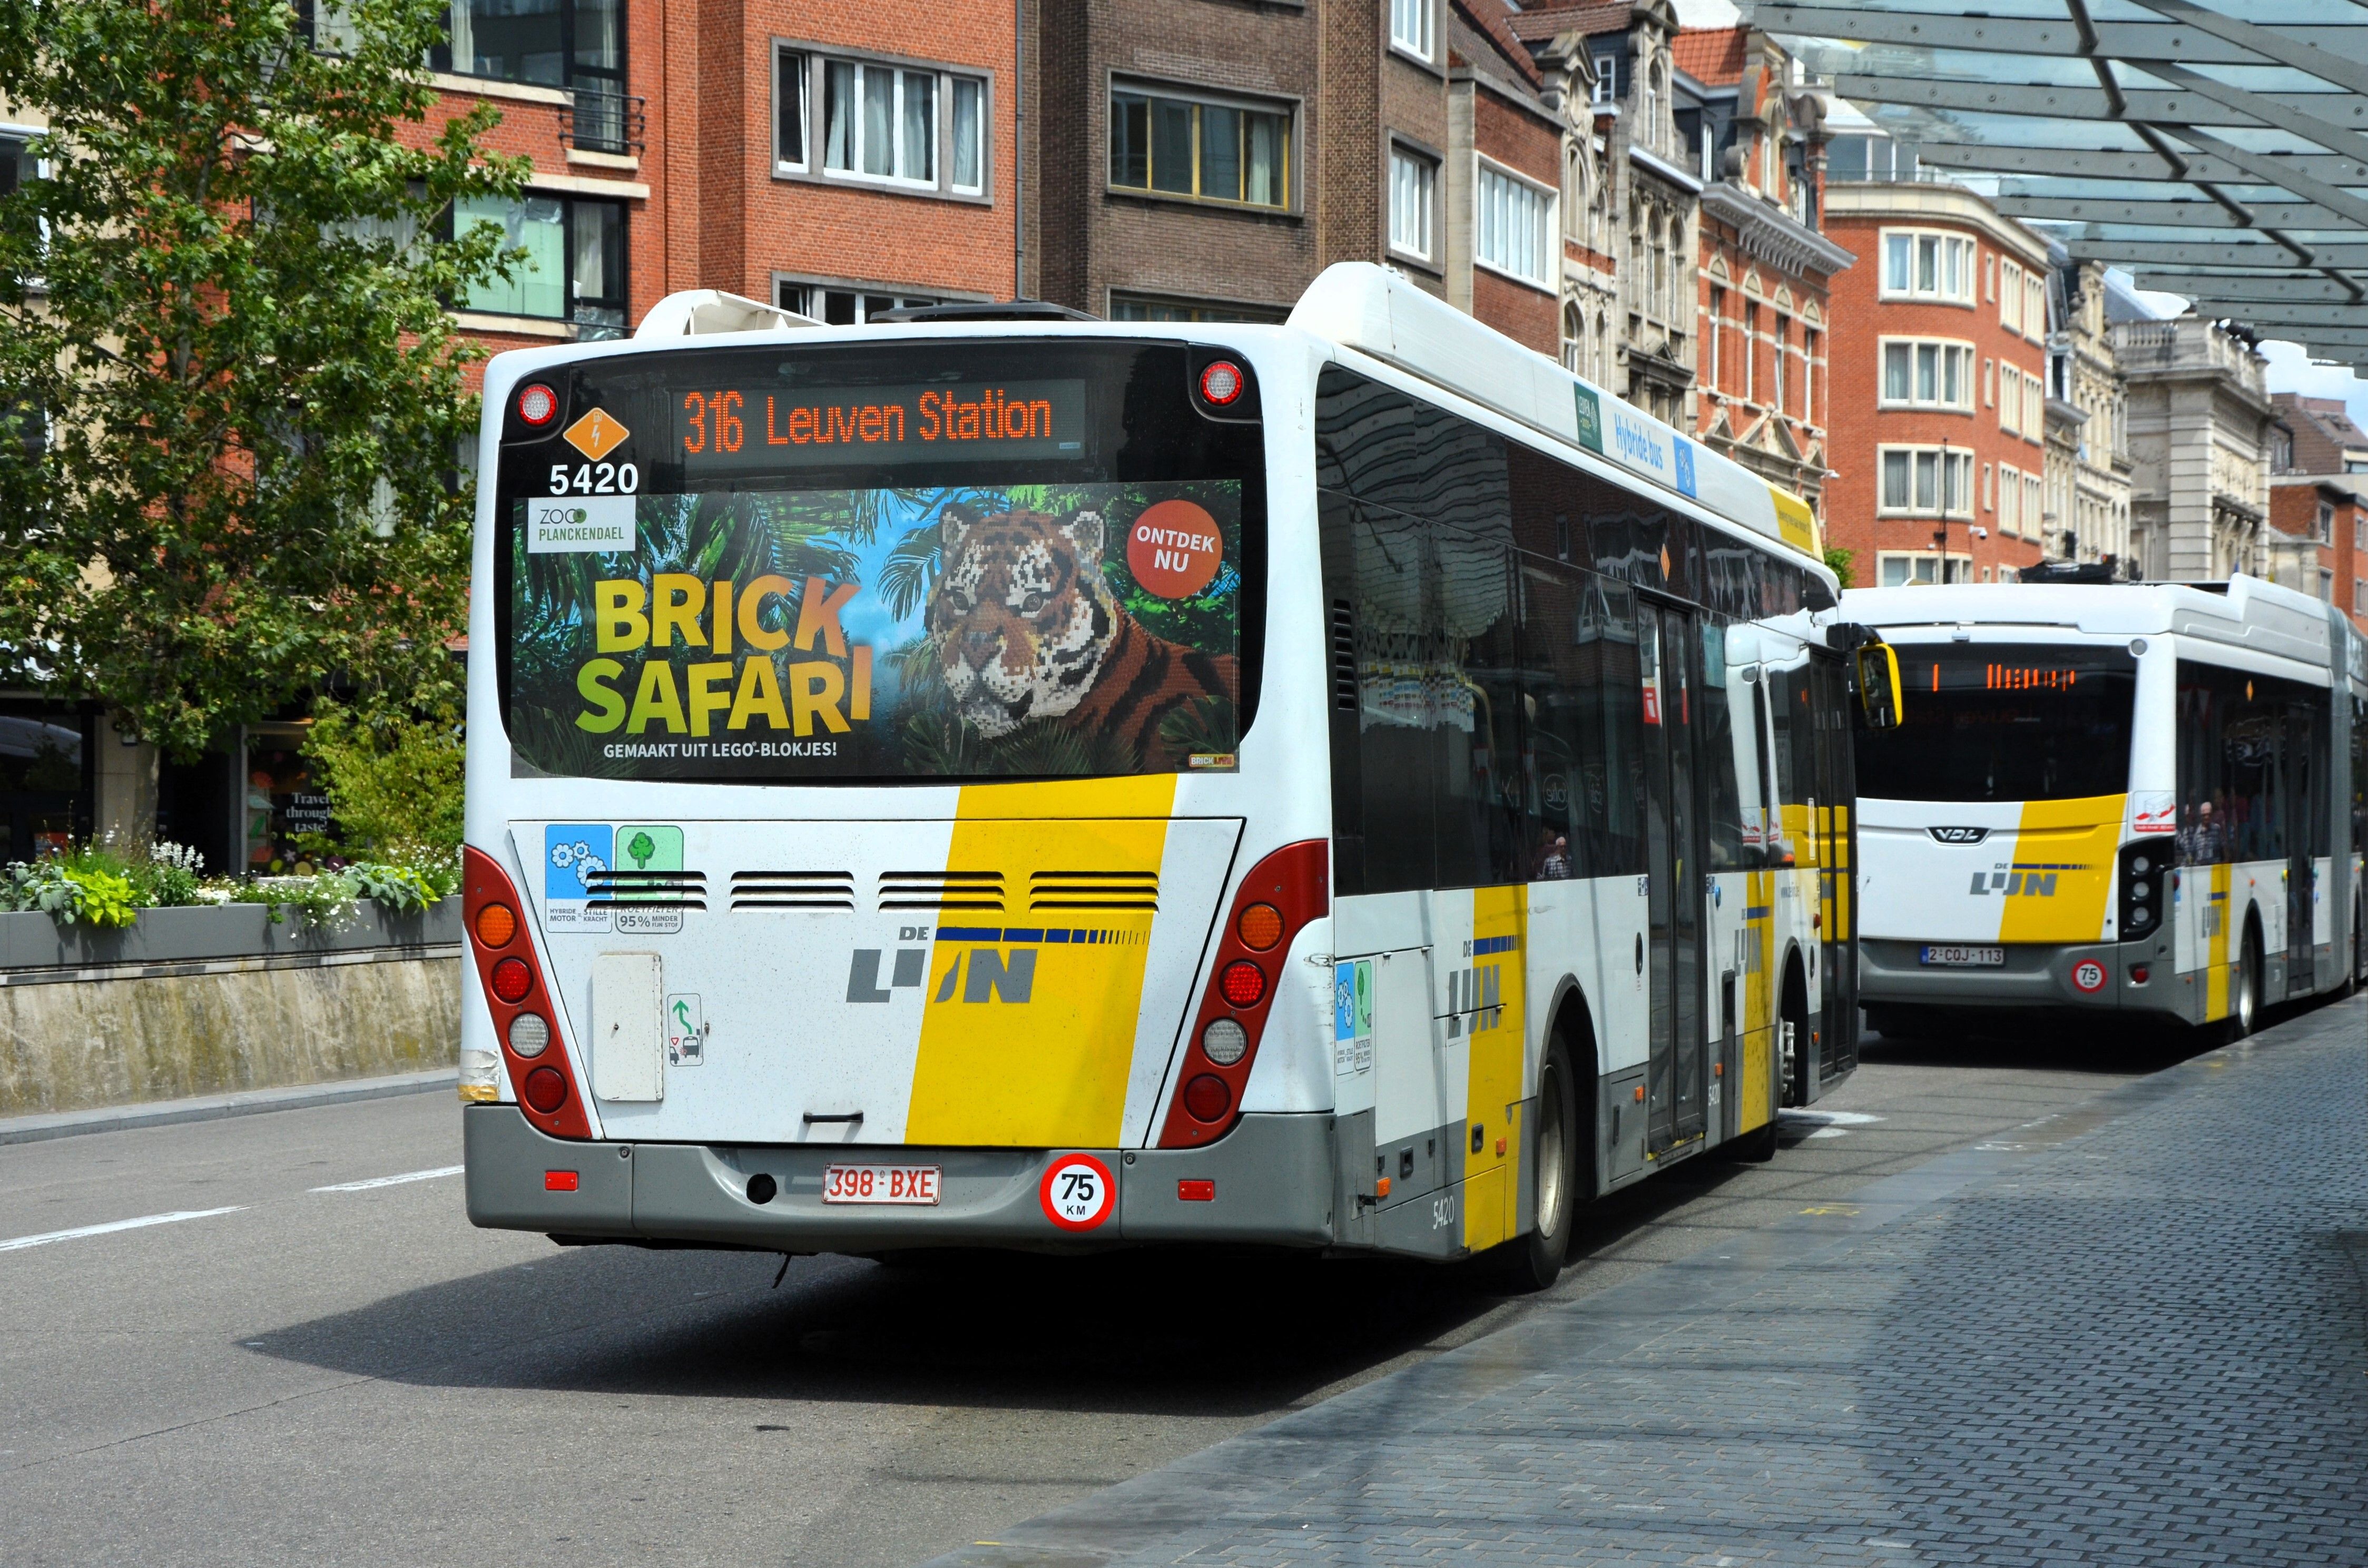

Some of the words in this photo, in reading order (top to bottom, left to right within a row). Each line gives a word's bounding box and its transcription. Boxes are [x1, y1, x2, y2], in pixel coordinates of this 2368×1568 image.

[684, 391, 743, 453] 316
[768, 396, 904, 445] Leuven
[919, 389, 1050, 440] Station
[1614, 412, 1648, 460] Hybride
[1648, 430, 1663, 470] bus
[549, 463, 638, 495] 5420
[539, 527, 624, 541] PLANCKENDAEL
[1136, 526, 1215, 553] ONTDEK
[1154, 549, 1189, 573] NU
[595, 573, 861, 658] BRICK
[575, 646, 872, 737] SAFARI
[604, 743, 676, 757] GEMAAKT
[682, 743, 708, 757] UIT
[291, 792, 329, 804] Travel
[295, 821, 327, 832] taste!
[1936, 829, 1979, 840] VDL
[1970, 872, 2058, 896] LIJN
[899, 927, 929, 940] DE
[1463, 940, 1471, 958] DE
[2080, 968, 2098, 980] 75
[1448, 964, 1500, 1040] LIJN
[829, 1169, 936, 1198] 398-BXE
[1062, 1173, 1095, 1201] 75
[1066, 1205, 1086, 1216] KM
[1433, 1195, 1454, 1230] 5420
